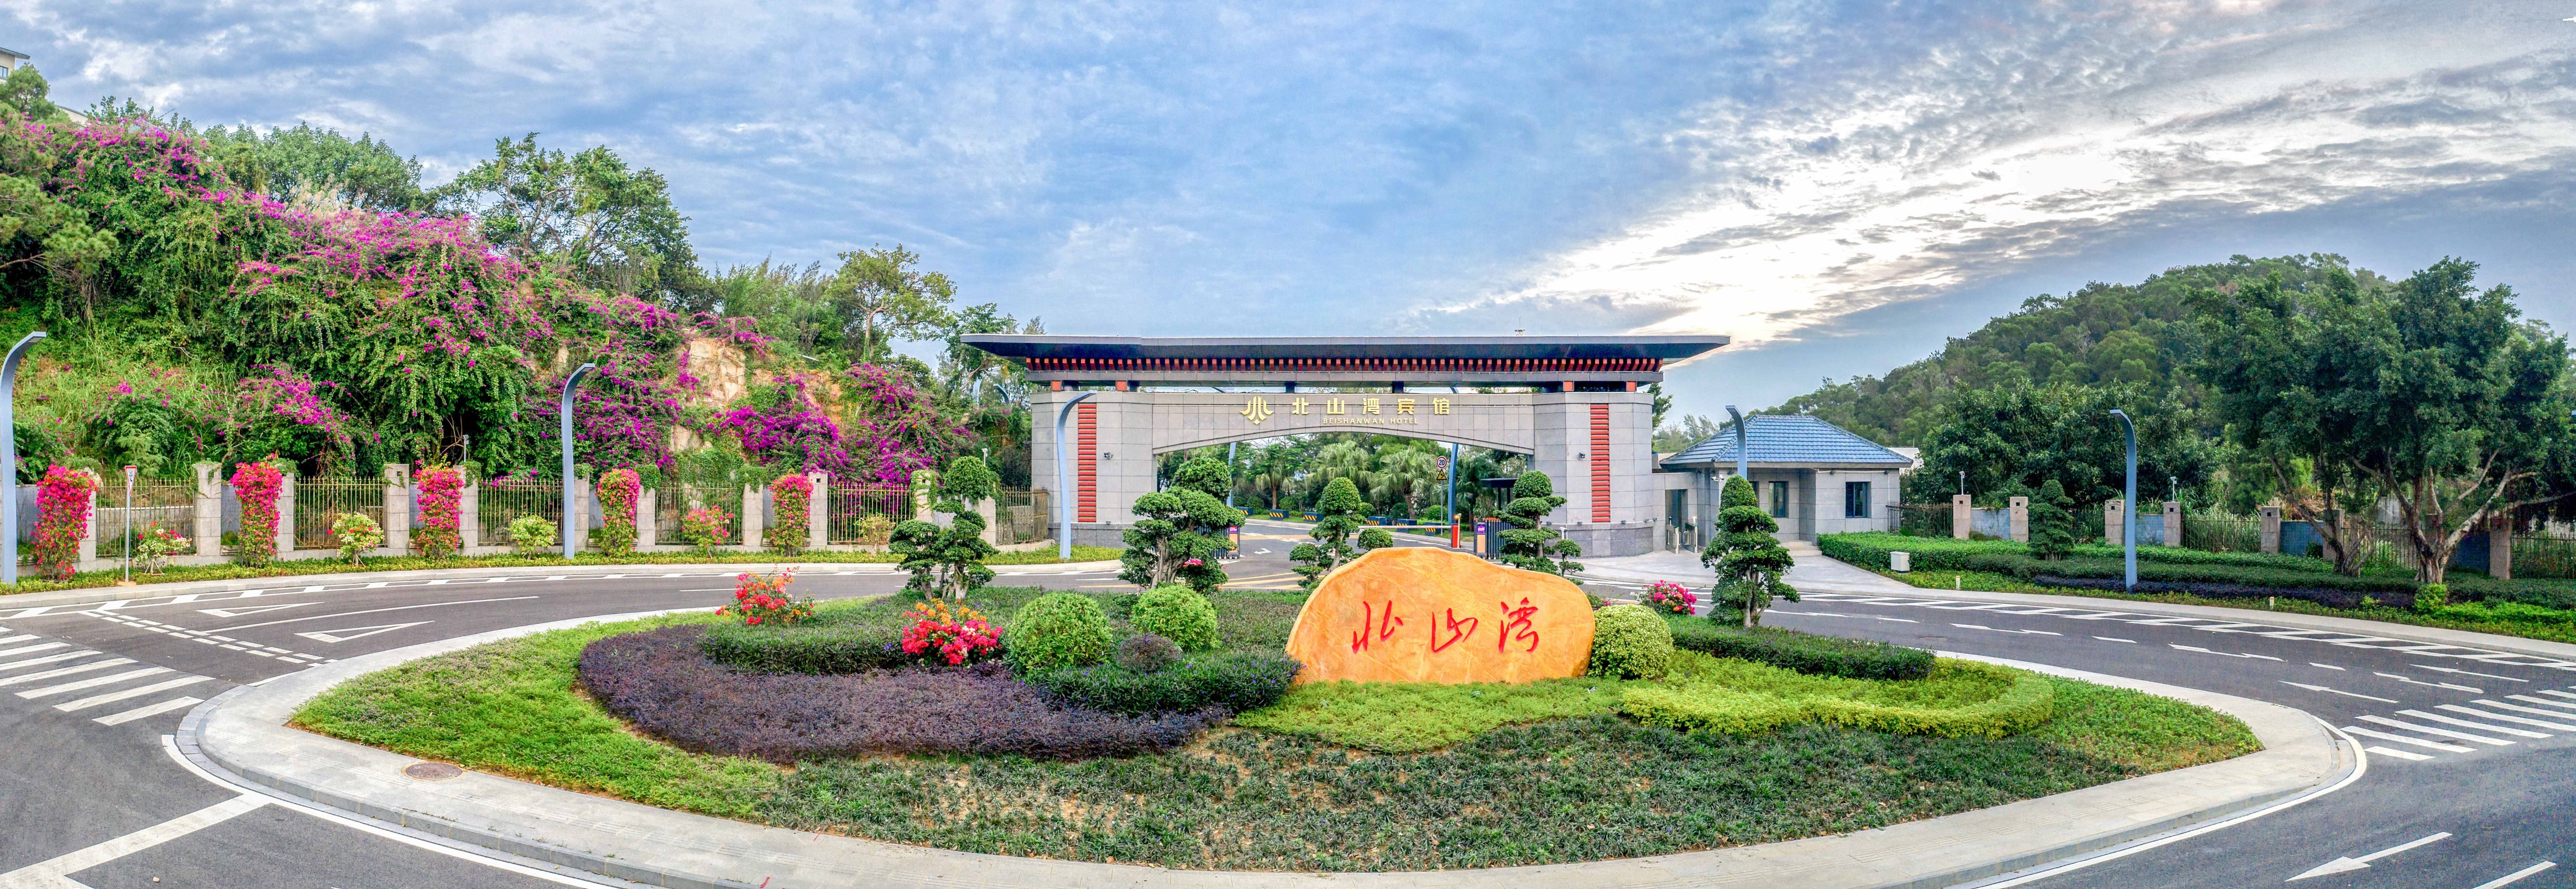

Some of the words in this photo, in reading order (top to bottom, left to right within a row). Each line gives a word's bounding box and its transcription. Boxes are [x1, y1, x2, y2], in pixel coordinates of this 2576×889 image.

[1292, 398, 1450, 415] 北山湾宾馆
[1352, 597, 1539, 654] 北山湾
